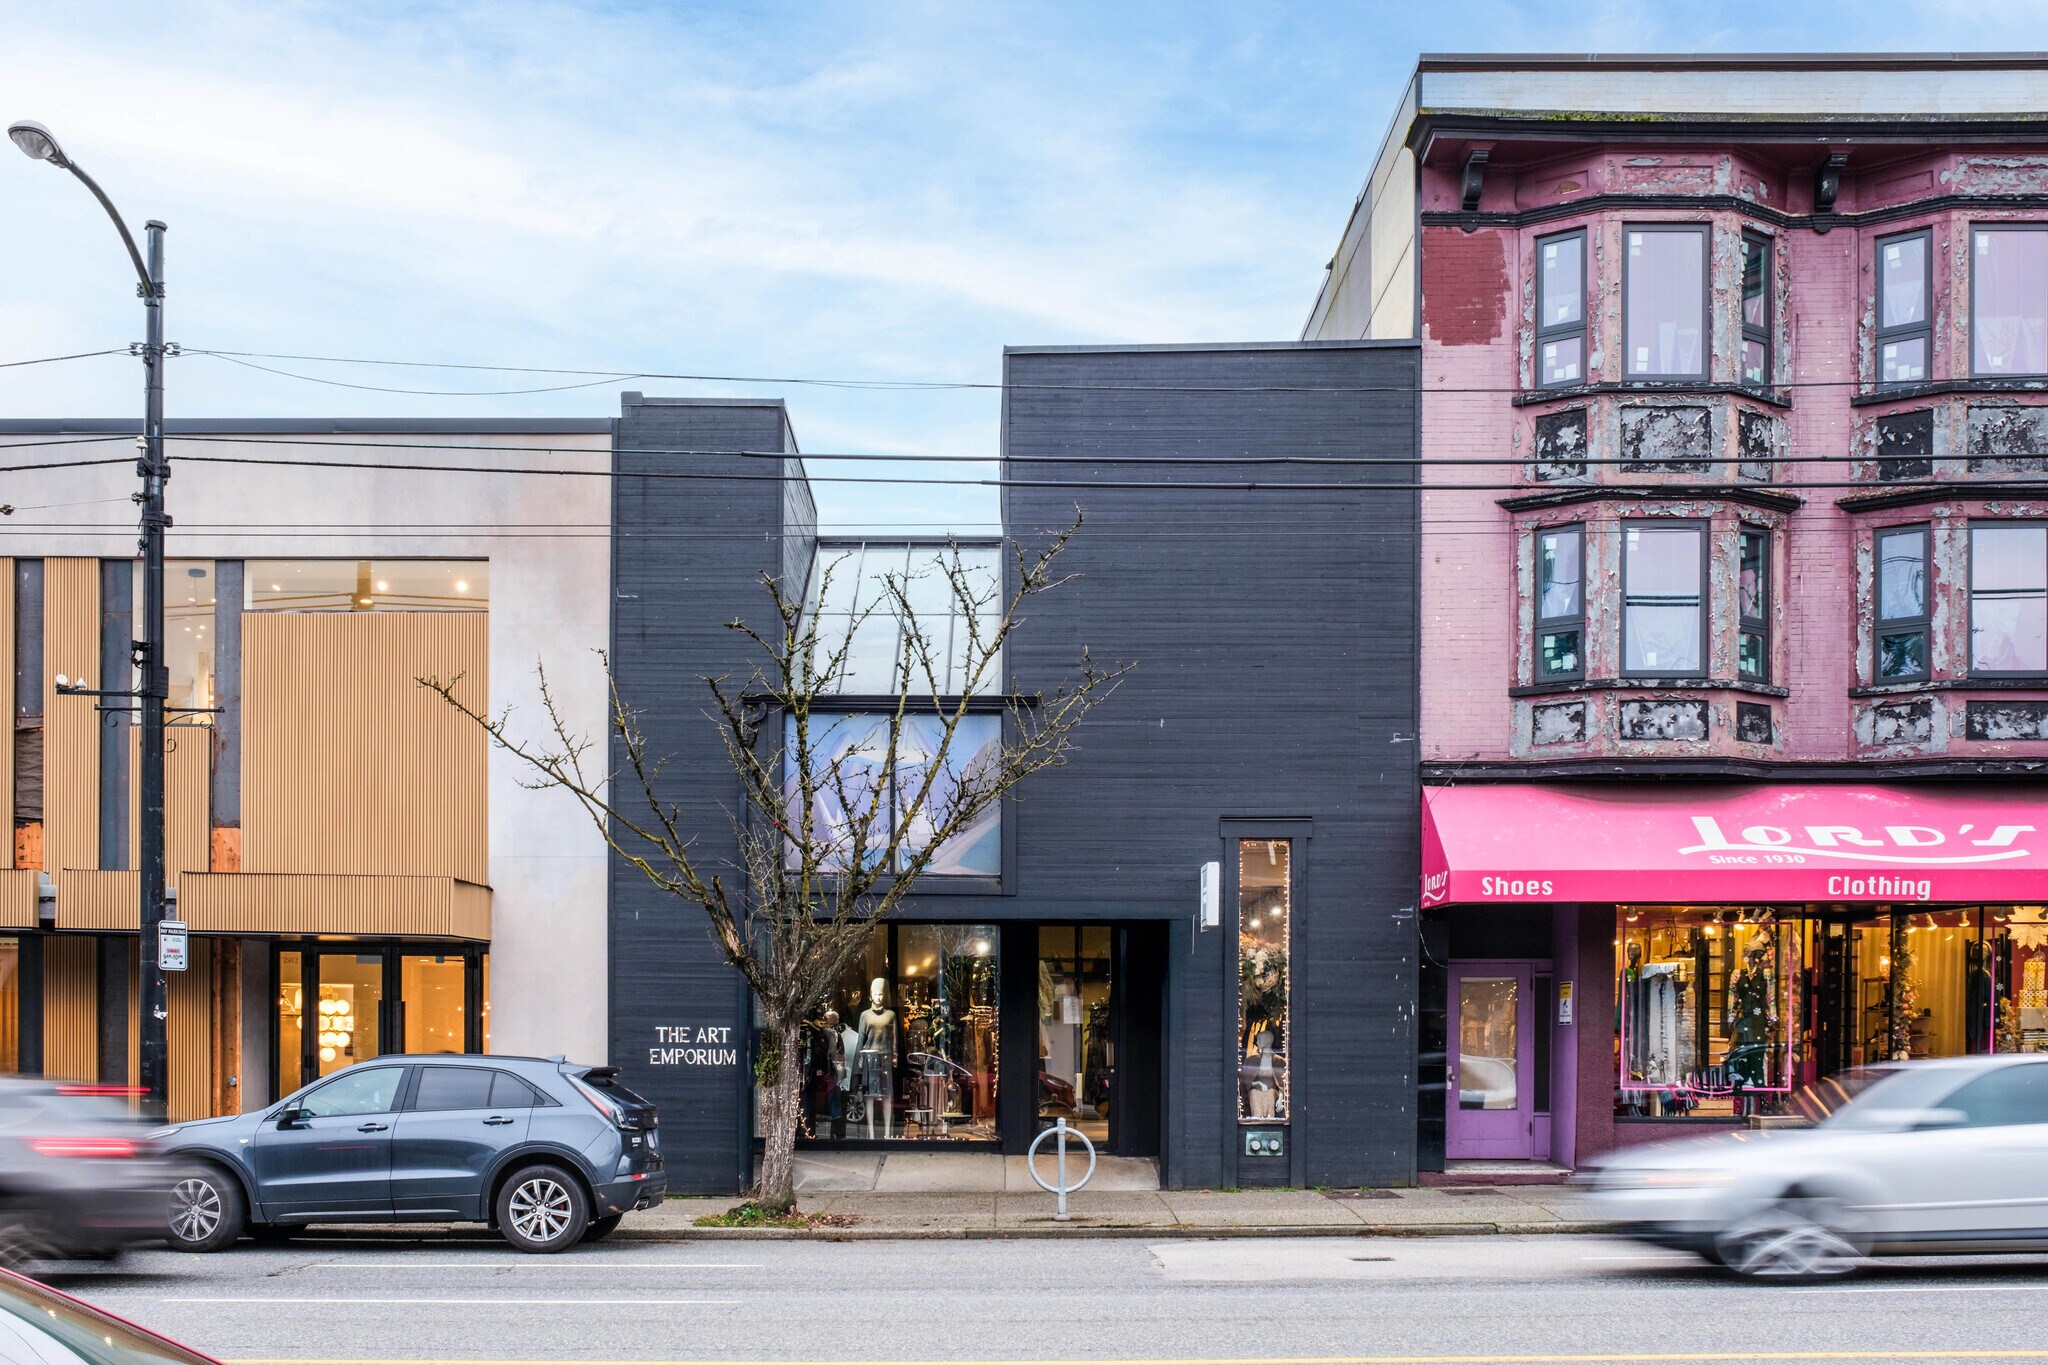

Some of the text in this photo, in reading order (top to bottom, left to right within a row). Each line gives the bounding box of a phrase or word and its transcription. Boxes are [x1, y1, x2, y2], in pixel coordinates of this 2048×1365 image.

[1684, 815, 2037, 857] LORD'S
[1708, 854, 1806, 864] Since 1930
[1481, 876, 1554, 896] Shoes
[1827, 875, 1931, 901] Clothing
[282, 956, 300, 964] 2912
[655, 1026, 731, 1043] THE ART
[649, 1048, 736, 1065] EMPORIUM
